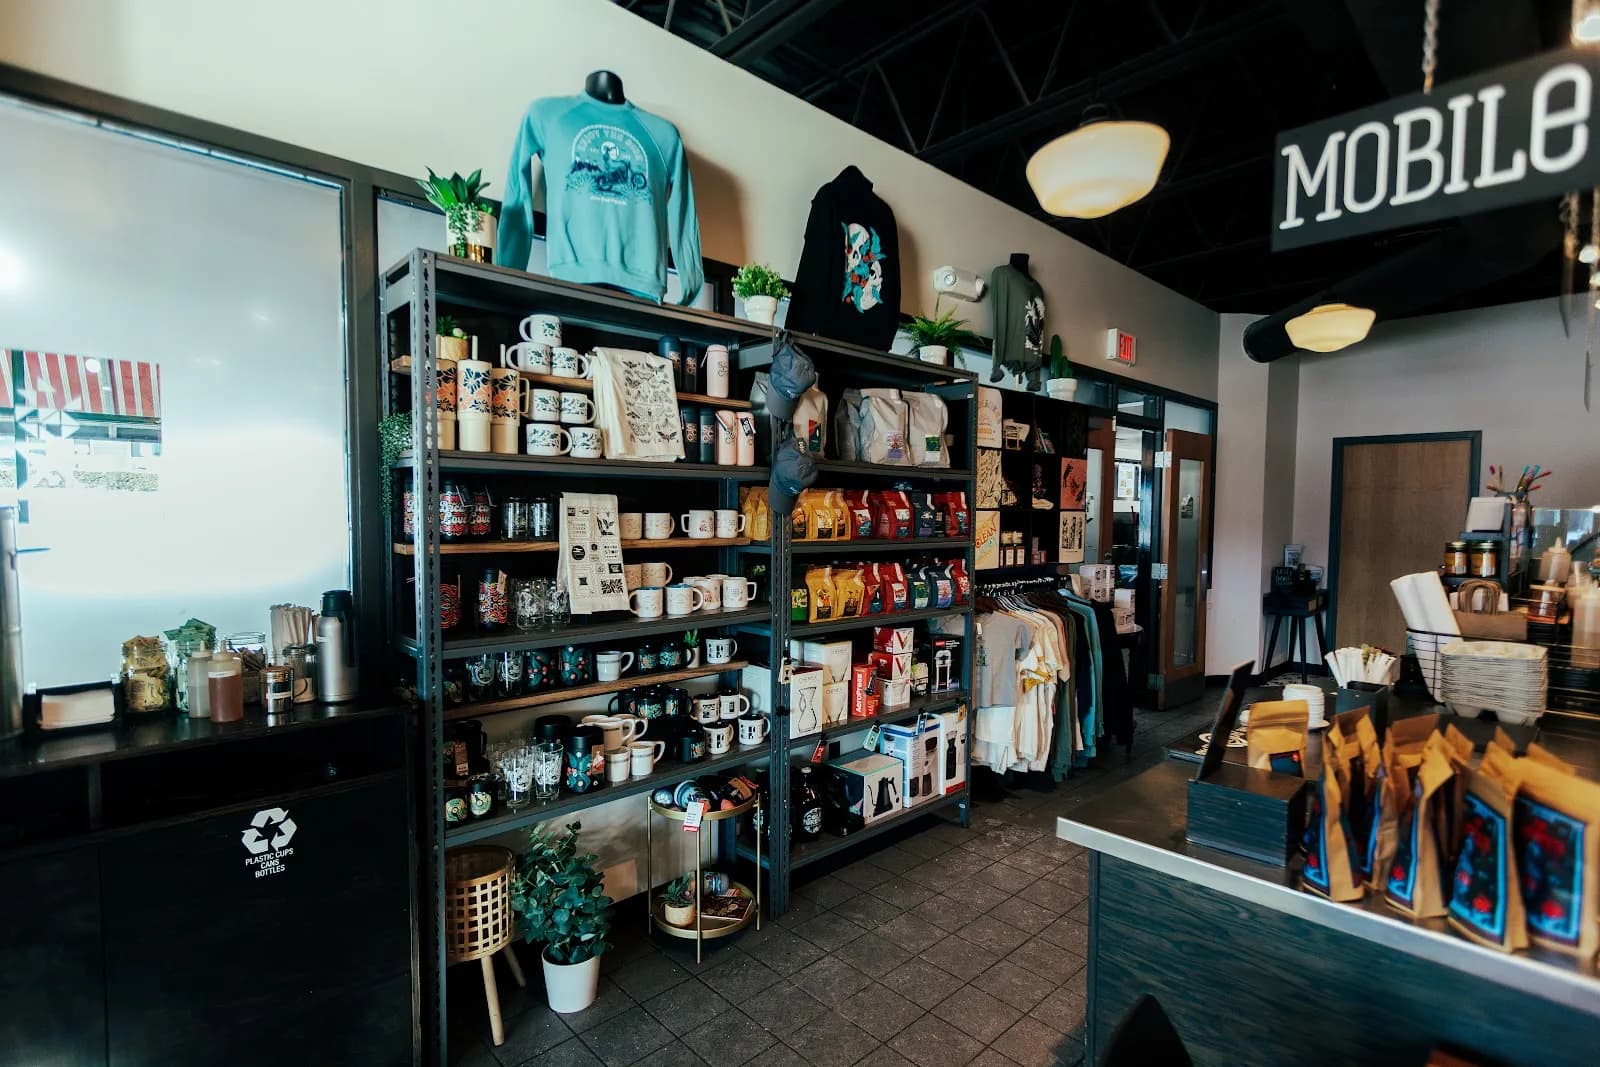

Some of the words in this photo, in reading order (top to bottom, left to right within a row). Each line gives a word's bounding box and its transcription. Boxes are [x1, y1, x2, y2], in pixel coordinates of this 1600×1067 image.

[245, 852, 275, 866] PLASTIC
[275, 848, 294, 858] CUPS
[260, 859, 280, 869] CANS
[255, 864, 286, 878] BOTTLES
